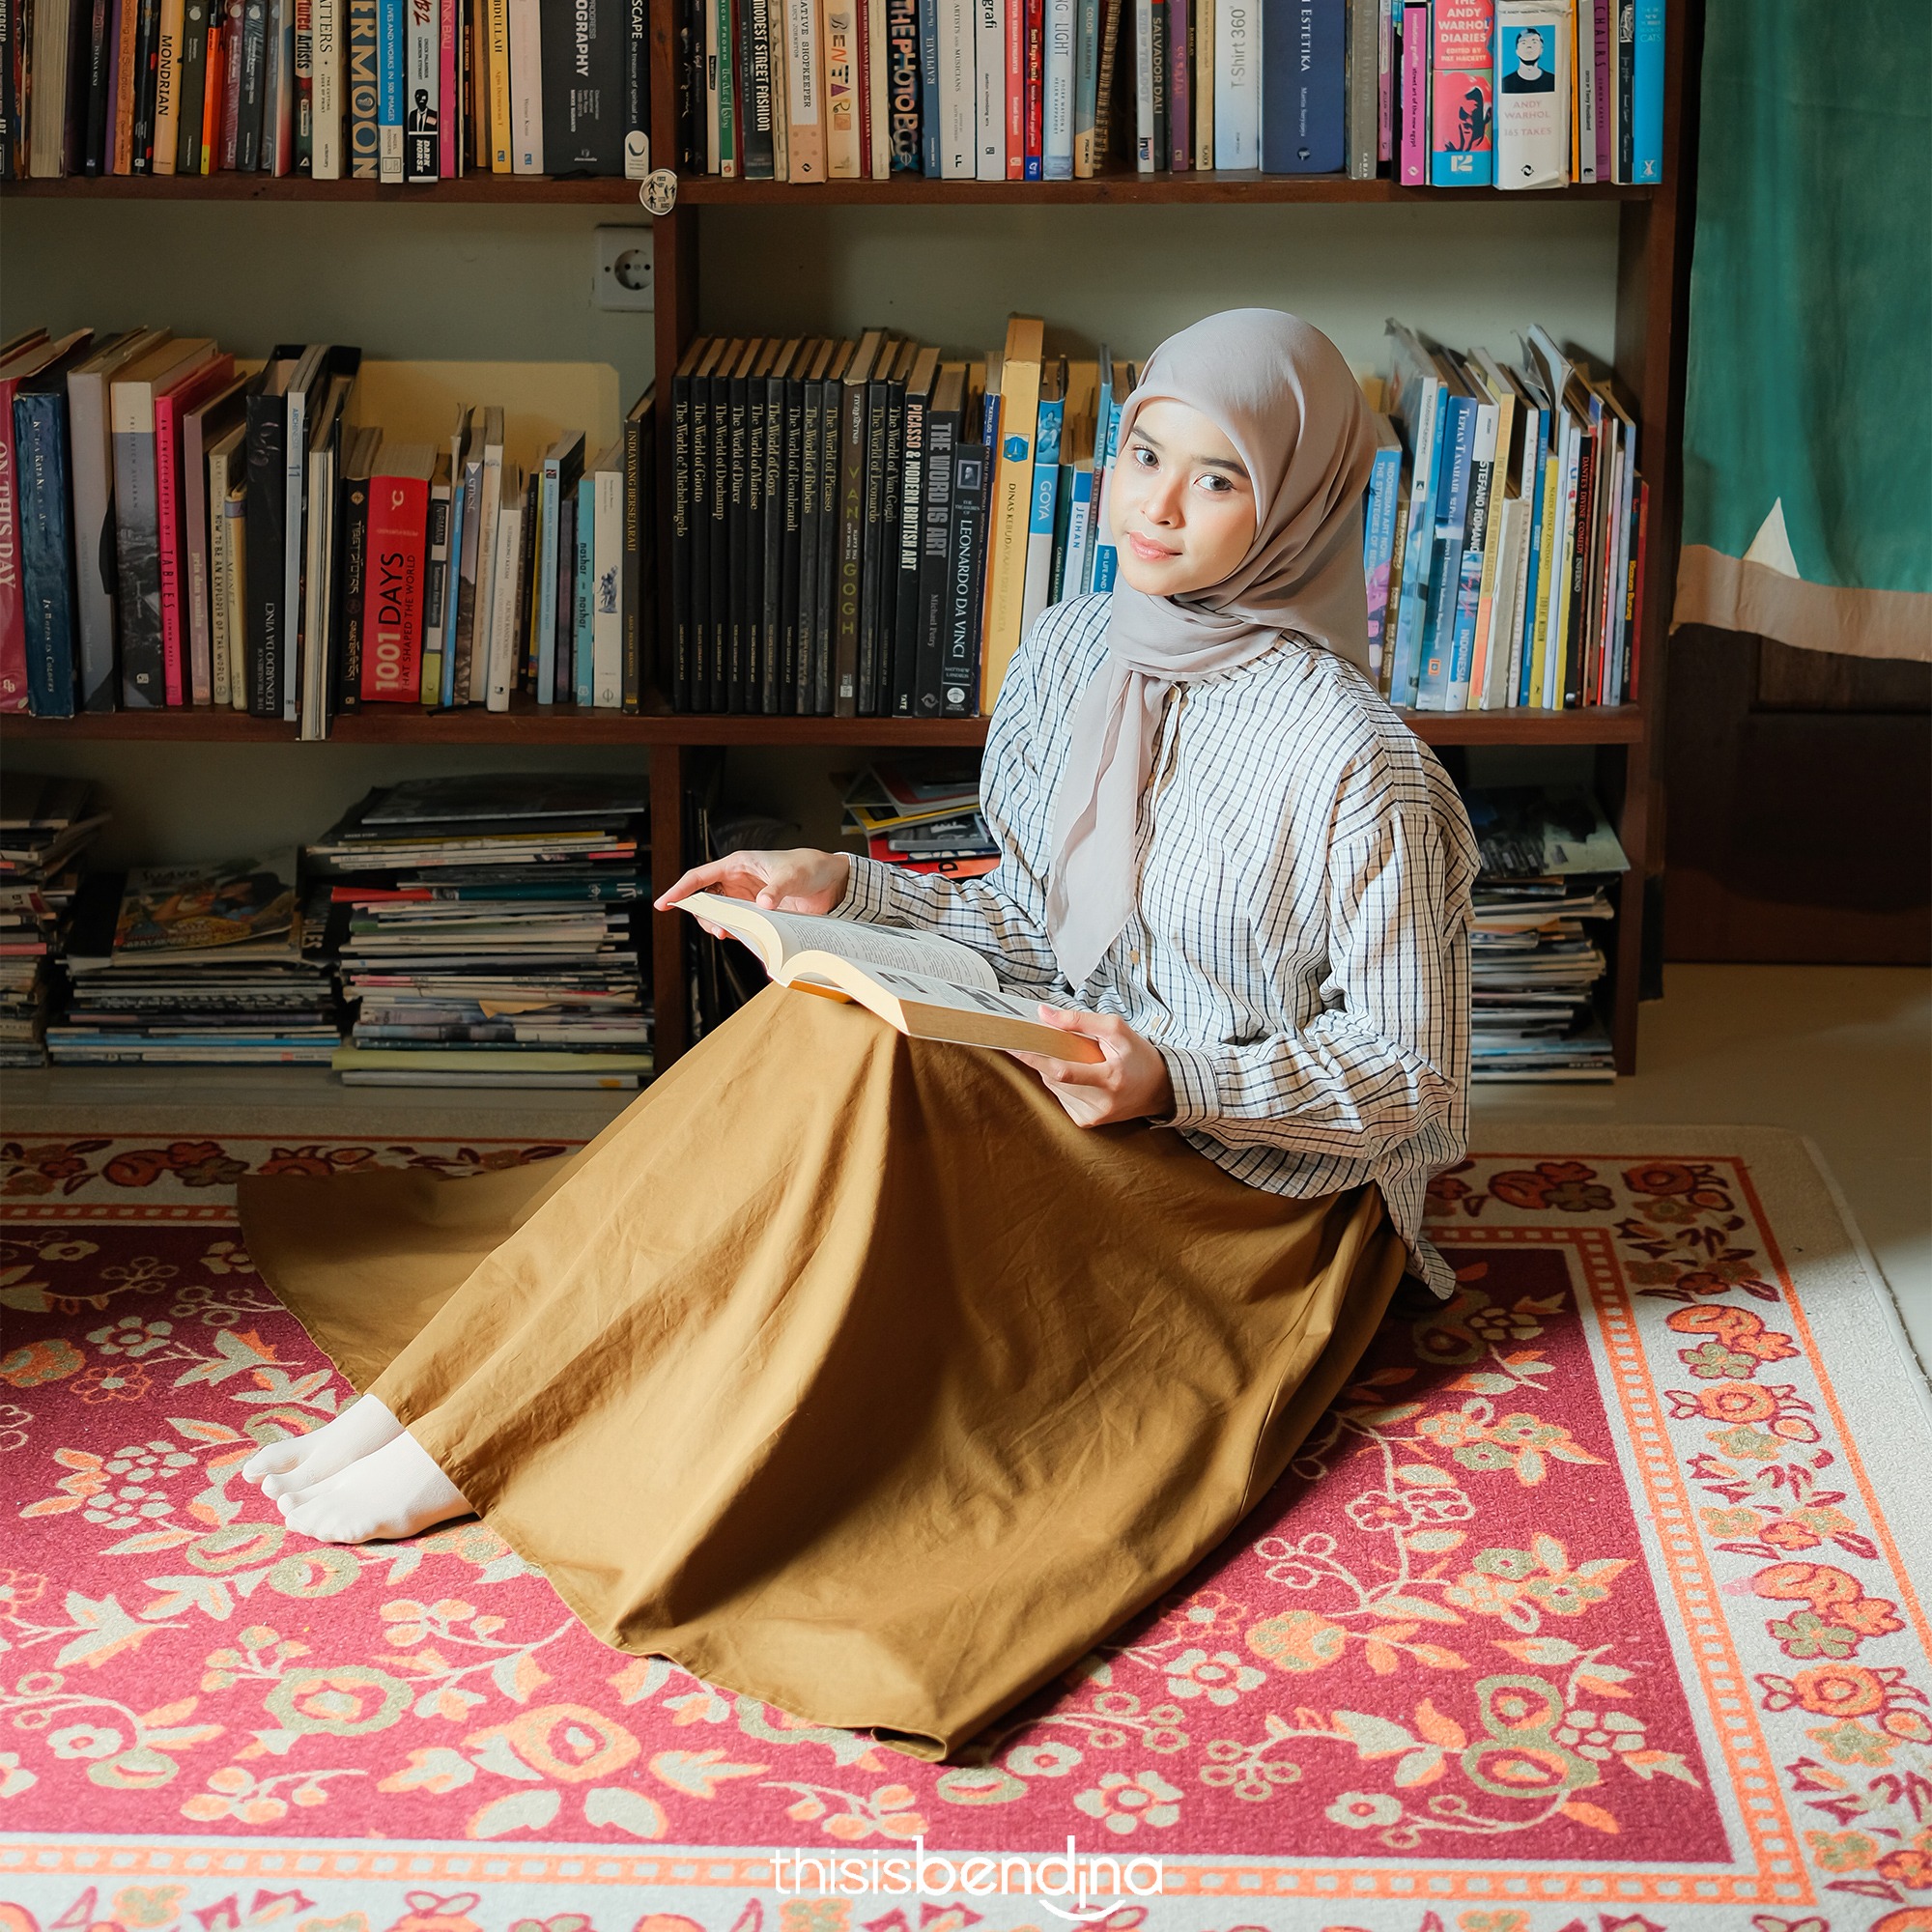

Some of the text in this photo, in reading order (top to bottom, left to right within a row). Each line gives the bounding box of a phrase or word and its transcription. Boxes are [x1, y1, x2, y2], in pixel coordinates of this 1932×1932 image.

[1054, 23, 1069, 57] LIGHT
[1300, 9, 1313, 71] ESTETIKA
[1437, 20, 1489, 30] WARHOL
[1440, 33, 1487, 43] DIARIES
[1446, 8, 1482, 17] ANDY
[1595, 6, 1606, 67] CHAIRS
[157, 35, 173, 116] MONDRIAN
[297, 34, 312, 70] Artists
[387, 71, 394, 80] IN
[753, 0, 770, 131] MODEST STREET FASHION
[802, 42, 811, 108] SHOPKEEPER
[926, 35, 935, 85] RAPHAEL
[1152, 16, 1163, 114] SALVADOR DALI
[1231, 43, 1247, 89] T-Shirt
[1504, 111, 1551, 120] WARHOL
[288, 464, 300, 477] 11
[673, 401, 688, 537] The World of Michelangelo
[695, 403, 706, 502] The World of Giotto
[712, 403, 727, 520] The World of Duchamp
[732, 405, 745, 504] The World of Dürer
[751, 404, 763, 510] The World of Matisse
[765, 402, 780, 496] The World of Goya
[786, 406, 801, 531] The World of Rembrandt
[804, 407, 817, 514] The World of Rubens
[824, 407, 838, 512] The World of Picasso
[868, 407, 884, 523] The World of Leonardo
[883, 407, 901, 523] The World of Van Gogh
[1451, 408, 1470, 493] TEPIAN TANAHAIR
[627, 431, 637, 551] INDIA YANG BERSEJARAH
[1007, 483, 1016, 511] DINAS
[1037, 480, 1053, 521] GOYA
[1371, 462, 1384, 533] THE STRATEGIES
[1381, 462, 1396, 534] INDONESIAN ART
[1474, 461, 1489, 506] STEFANO
[214, 547, 222, 556] BE
[434, 506, 446, 544] NIRMANA
[925, 422, 952, 626] THE WORD IS ART Michael
[1072, 507, 1085, 549] JEIHAN
[1577, 521, 1586, 554] COMEDY
[162, 550, 175, 608] TABLES
[215, 561, 223, 573] AN
[579, 543, 590, 629] nashar nashar
[899, 404, 923, 710] PICASSO & MODERN BRITISH ART TATE
[956, 520, 973, 595] LEONARDO
[1100, 573, 1109, 588] AND
[1574, 557, 1584, 592] INFERNO
[215, 576, 224, 617] EXPLORER
[378, 553, 404, 625] DAYS
[955, 598, 968, 616] DA
[1625, 592, 1634, 620] Burung
[216, 620, 224, 630] OF
[401, 555, 416, 692] THAT SHAPED THE WORLD
[952, 620, 966, 658] VINCI
[265, 603, 275, 711] LEONARDO DA VINCI
[375, 632, 401, 692] 1001
[1456, 629, 1470, 682] INDONESIA
